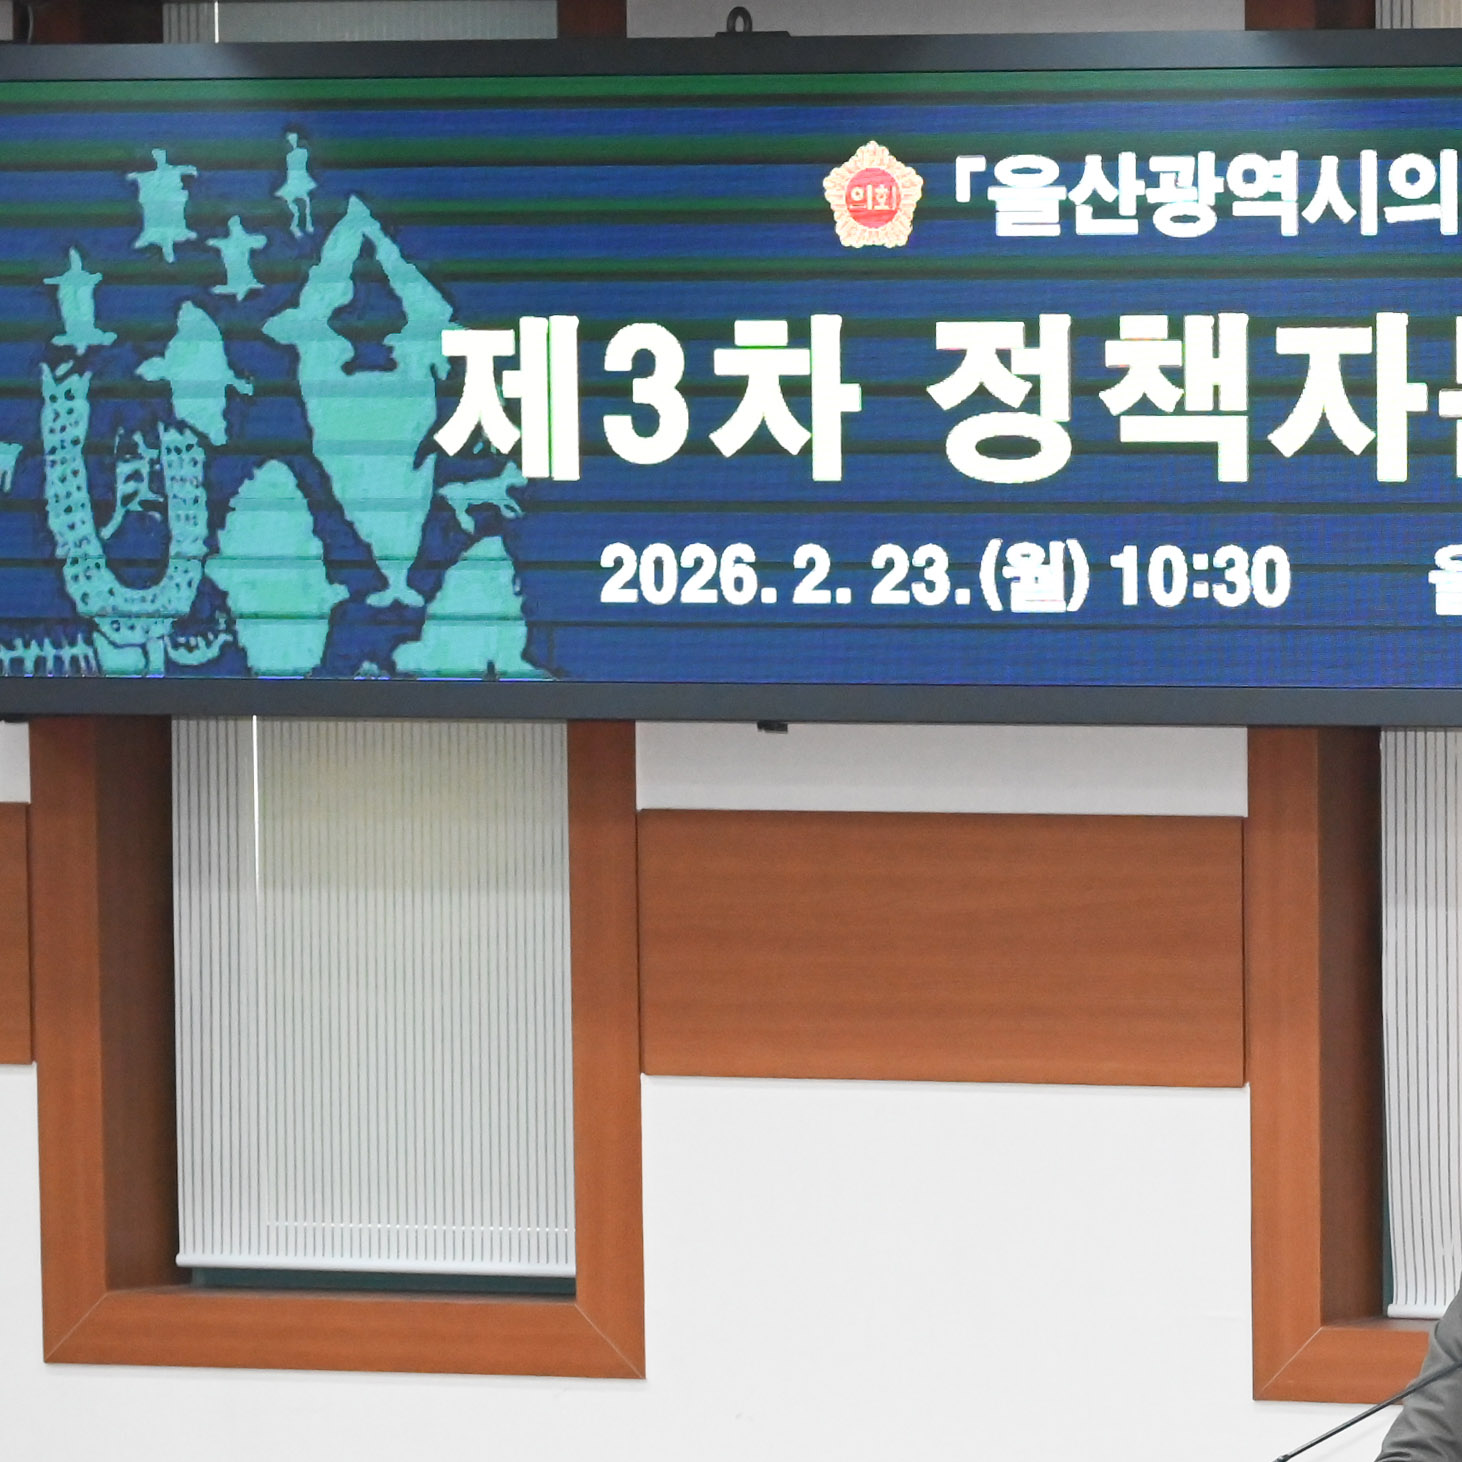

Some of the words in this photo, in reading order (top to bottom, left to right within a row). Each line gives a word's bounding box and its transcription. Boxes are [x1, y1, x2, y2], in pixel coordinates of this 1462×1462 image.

[850, 184, 898, 211] 의회
[433, 313, 863, 483] 제3차
[600, 542, 777, 606] 2026.
[792, 543, 852, 606] 2.
[870, 538, 1090, 613] 23.(월)
[1110, 544, 1291, 608] 10:30
